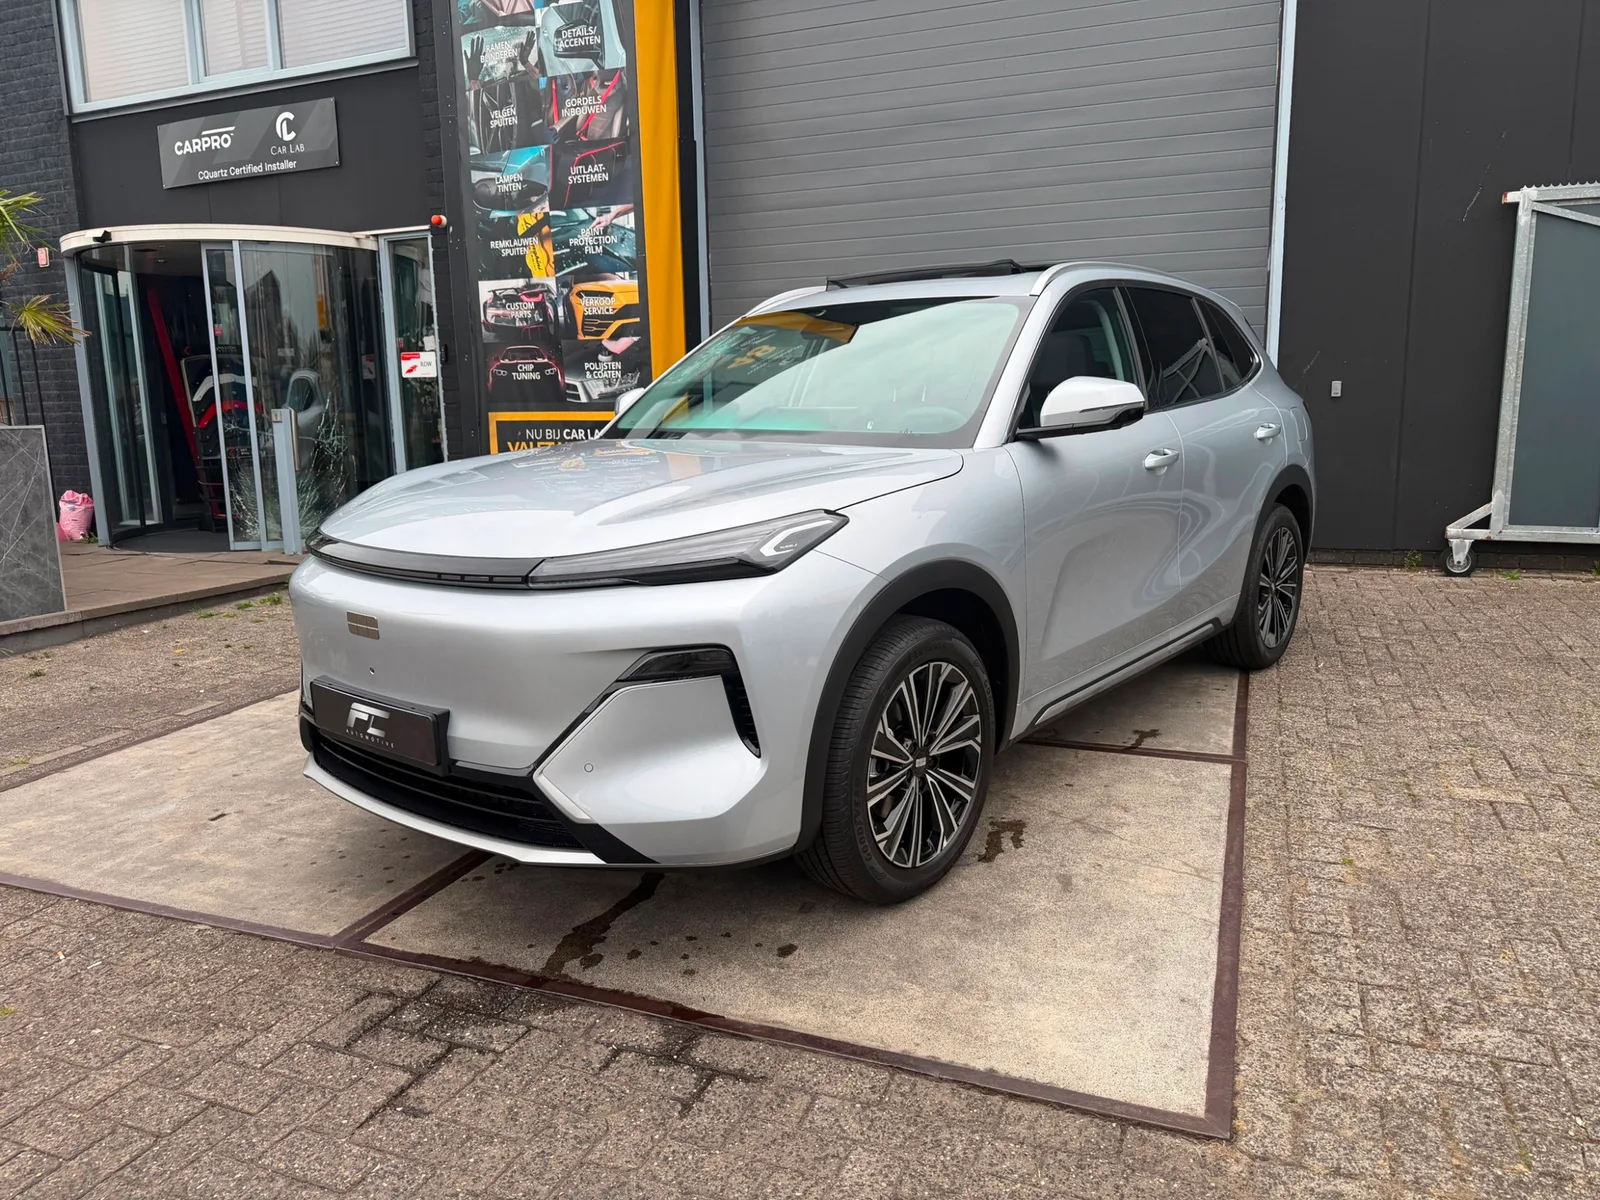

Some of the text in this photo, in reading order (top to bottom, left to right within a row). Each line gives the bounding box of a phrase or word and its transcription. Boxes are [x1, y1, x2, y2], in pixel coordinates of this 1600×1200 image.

[561, 26, 597, 39] DETAILS/
[559, 35, 601, 48] ACCENTEN
[565, 95, 602, 108] GORDELS
[489, 107, 516, 120] VELGEN
[561, 104, 607, 117] INBOUWEN
[489, 116, 518, 129] SPUITEN
[174, 134, 232, 155] CARPRO
[270, 143, 305, 156] CAR LAB
[198, 160, 297, 180] CQuartz Certified Installer
[570, 163, 606, 175] UITLAAT-
[494, 172, 523, 185] LAMPEN
[568, 172, 609, 185] SYSTEMEN
[497, 181, 522, 193] TINTEN
[580, 227, 604, 237] PAINT
[490, 237, 539, 249] REMKLAUWEN
[569, 235, 618, 247] PROTECTION
[501, 246, 529, 257] SPUITEN
[584, 245, 603, 255] FILM
[505, 301, 535, 311] CUSTOM
[580, 297, 616, 307] VERKOOP
[509, 310, 532, 320] PARTS
[583, 306, 614, 316] SERVICE
[517, 363, 534, 373] CHIP
[584, 361, 622, 371] POLIJSTEN
[511, 371, 541, 381] TUNING
[585, 369, 622, 380] & COATEN
[525, 428, 600, 440] NU BIJ CAR LA
